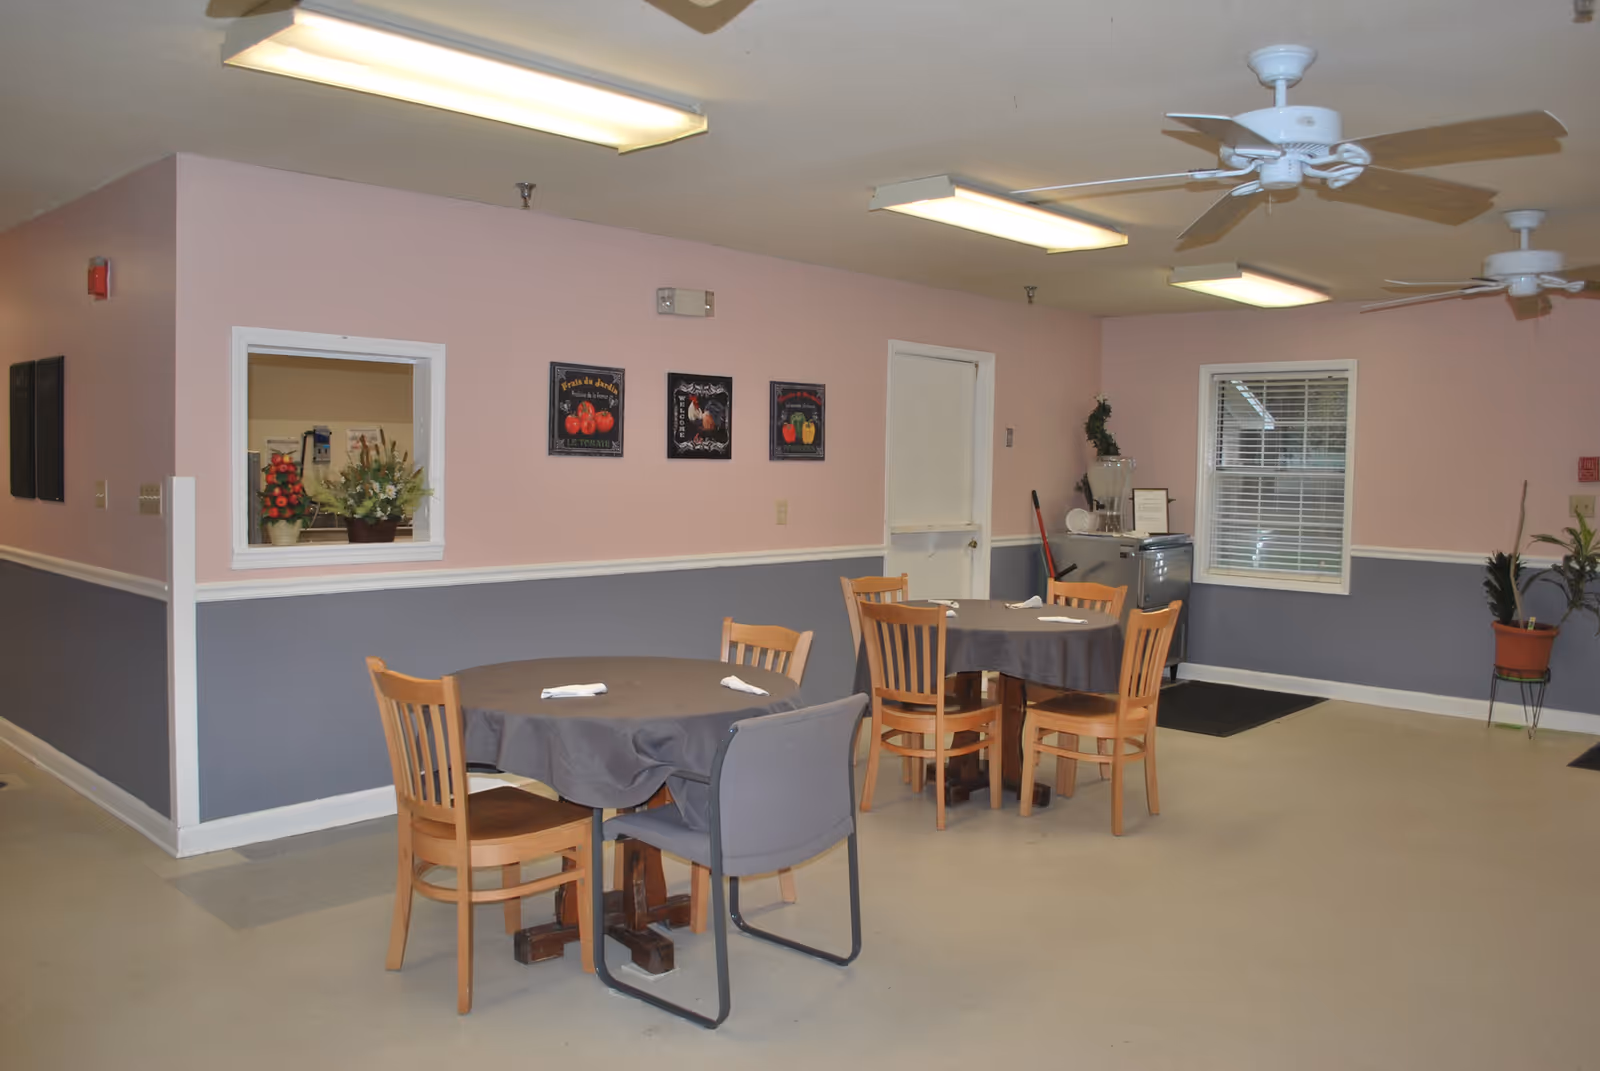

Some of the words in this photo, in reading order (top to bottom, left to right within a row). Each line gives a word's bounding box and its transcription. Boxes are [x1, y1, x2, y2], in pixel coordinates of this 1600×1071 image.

[584, 376, 593, 385] du
[594, 378, 618, 395] Jardin
[678, 395, 686, 438] WELCOME
